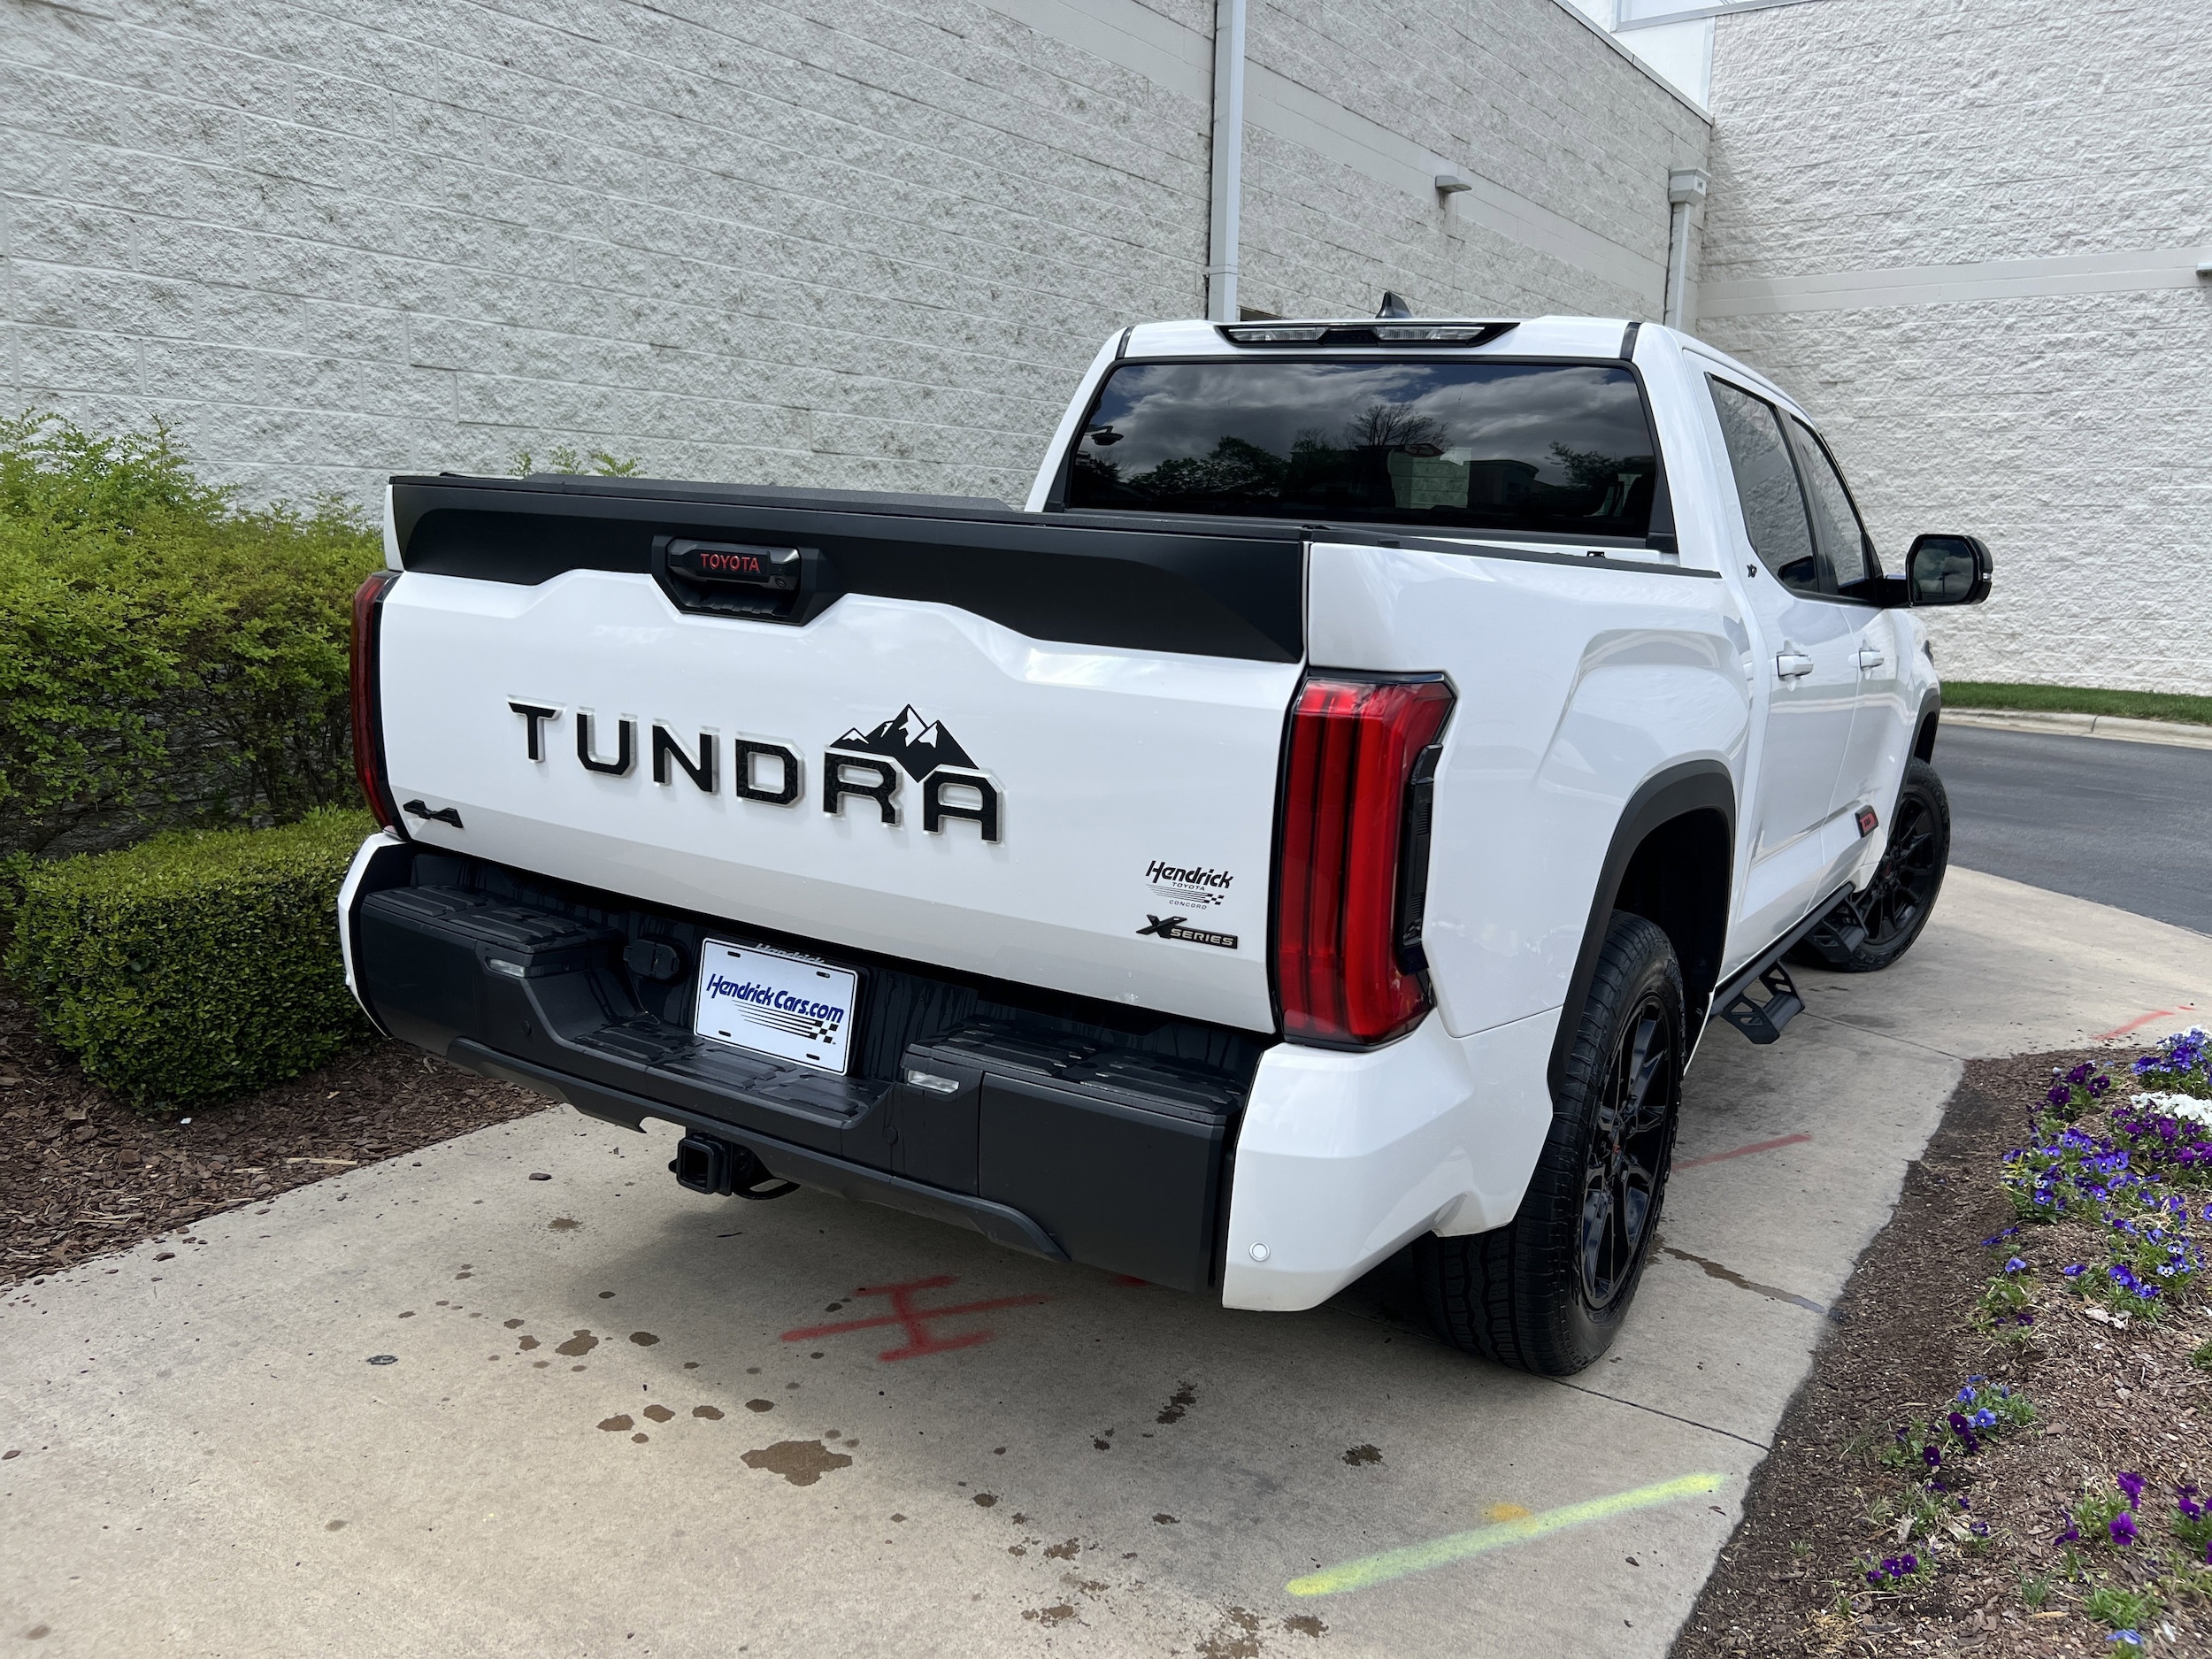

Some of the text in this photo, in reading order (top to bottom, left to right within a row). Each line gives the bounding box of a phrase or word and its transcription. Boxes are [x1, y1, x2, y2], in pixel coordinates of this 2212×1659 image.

[701, 553, 760, 573] TOYOTA
[507, 695, 1003, 843] TUNDRA
[1145, 860, 1234, 888] Hendrick
[1172, 881, 1205, 891] TOYOTA
[1169, 899, 1207, 910] CONCORD
[1170, 927, 1233, 946] SERIES
